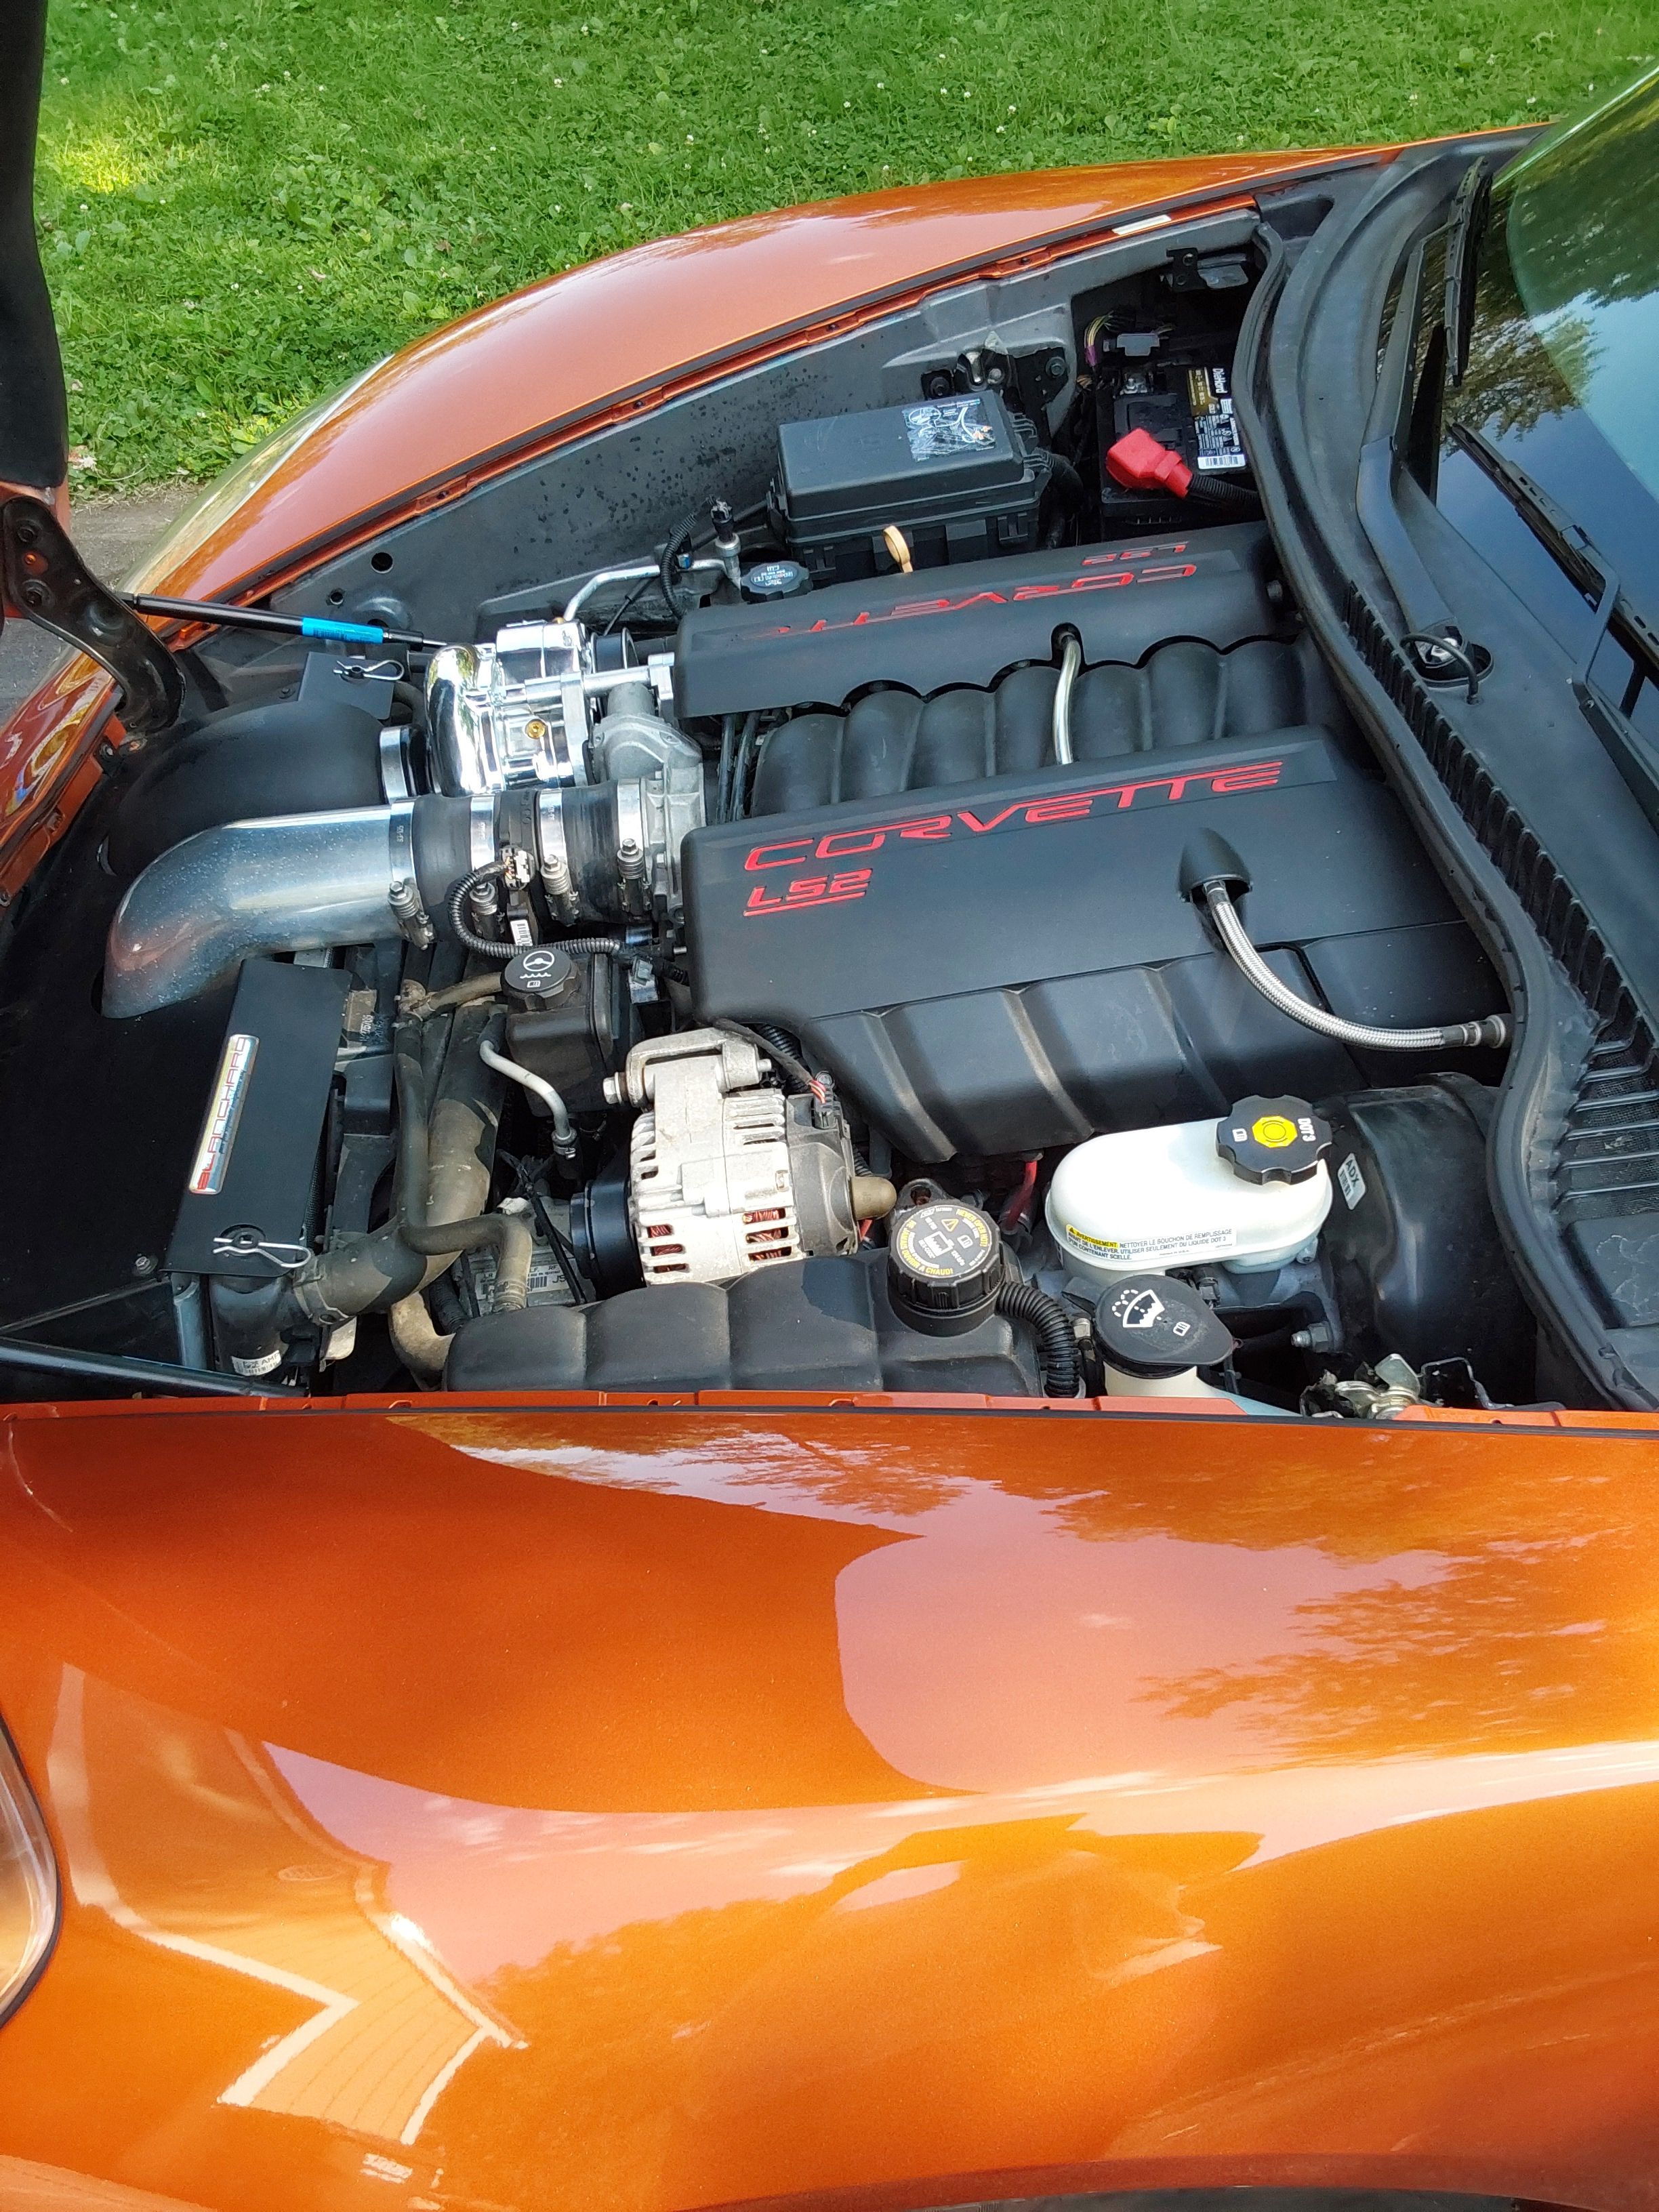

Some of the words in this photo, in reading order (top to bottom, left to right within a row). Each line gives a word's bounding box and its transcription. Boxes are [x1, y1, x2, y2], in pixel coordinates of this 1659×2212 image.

[743, 762, 1283, 871] CORVETTE
[745, 867, 873, 911] LS2
[1298, 1118, 1315, 1135] DOT
[1346, 1159, 1359, 1185] ADX
[956, 1208, 977, 1222] NEVER
[974, 1219, 987, 1234] OPEN
[900, 1227, 910, 1250] JAMAIS
[1069, 1232, 1081, 1243] AVANT
[1146, 1243, 1178, 1252] SEULEMENT
[1076, 1231, 1117, 1247] AVERTISSEMENT
[1120, 1240, 1147, 1248] NETTOYER
[1157, 1236, 1184, 1244] BOUCHON
[1194, 1229, 1232, 1239] REMPLISSAGE
[902, 1250, 921, 1269] OUVRIR
[1079, 1244, 1108, 1258] CONTENANT
